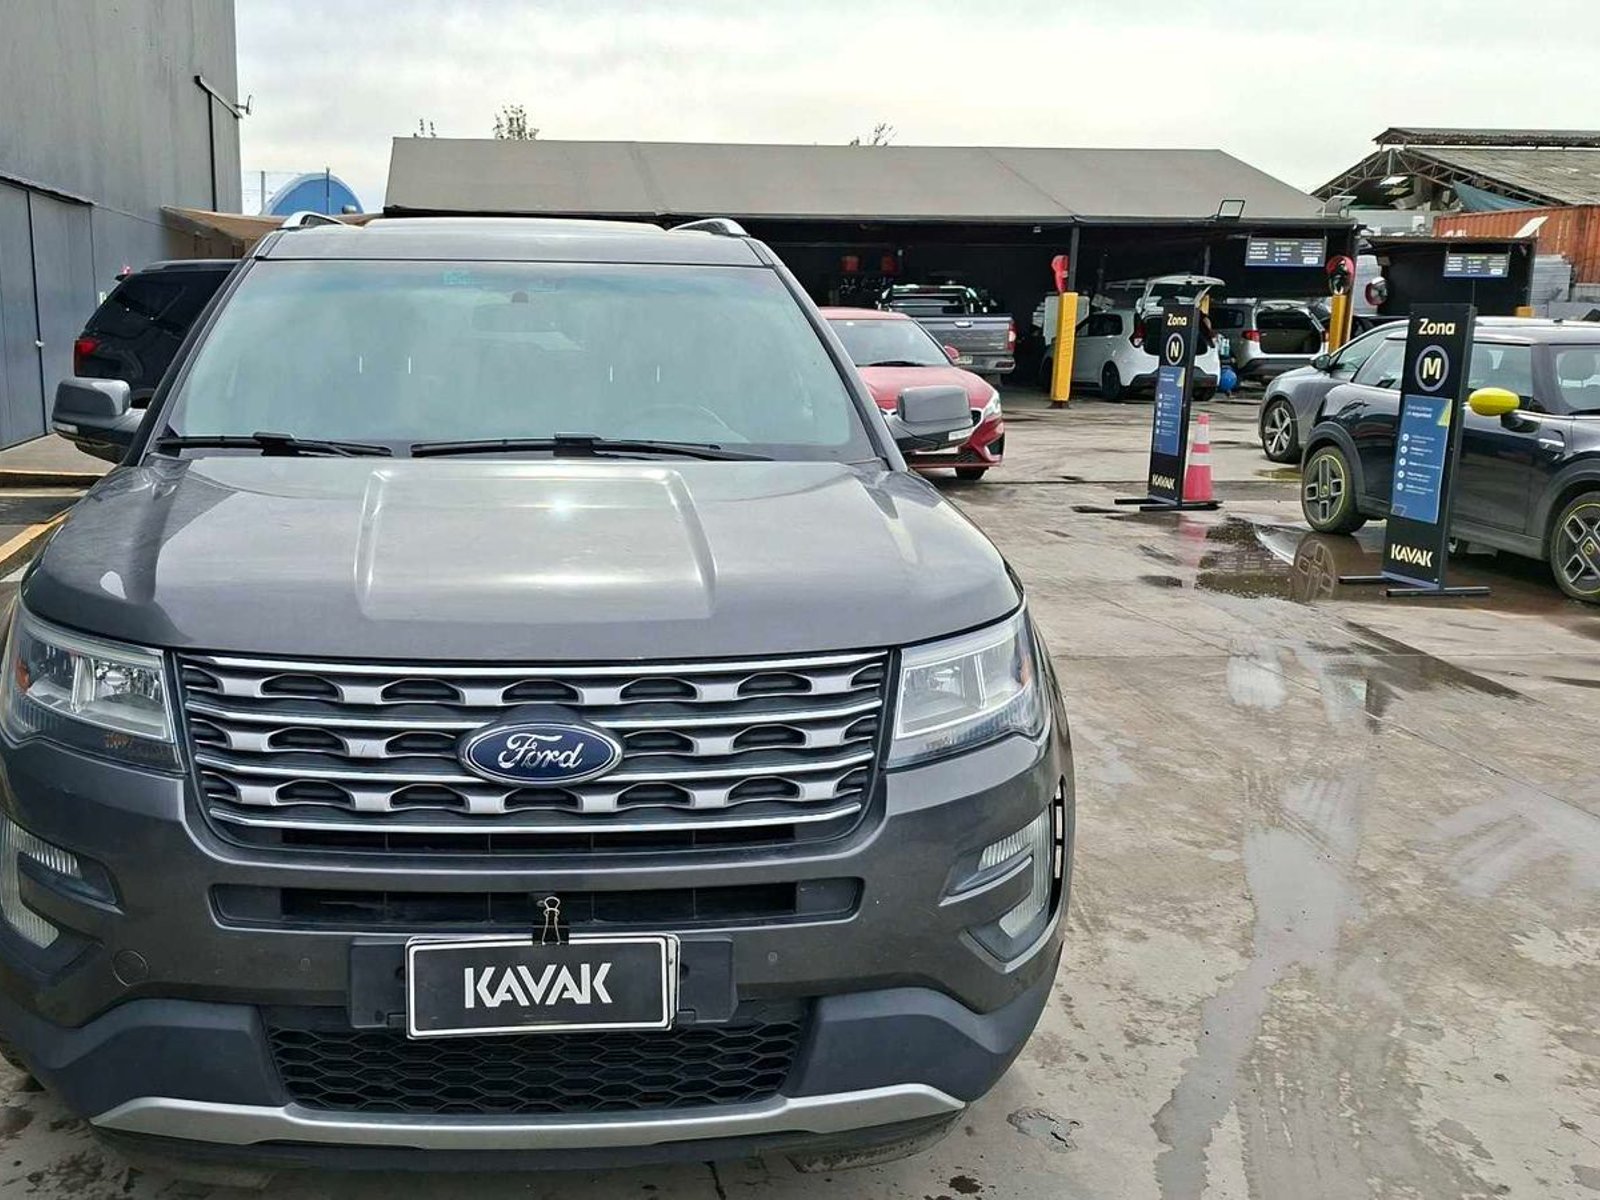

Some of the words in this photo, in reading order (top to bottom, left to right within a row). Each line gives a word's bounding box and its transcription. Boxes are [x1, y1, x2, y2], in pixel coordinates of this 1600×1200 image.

[1167, 313, 1187, 326] Zona
[1418, 318, 1456, 335] Zona
[1170, 341, 1179, 358] N
[1422, 357, 1442, 379] M
[1152, 474, 1175, 490] KAVAK
[1391, 543, 1433, 567] KAVAK
[498, 733, 584, 769] Ford
[464, 963, 613, 1009] KAVAK
